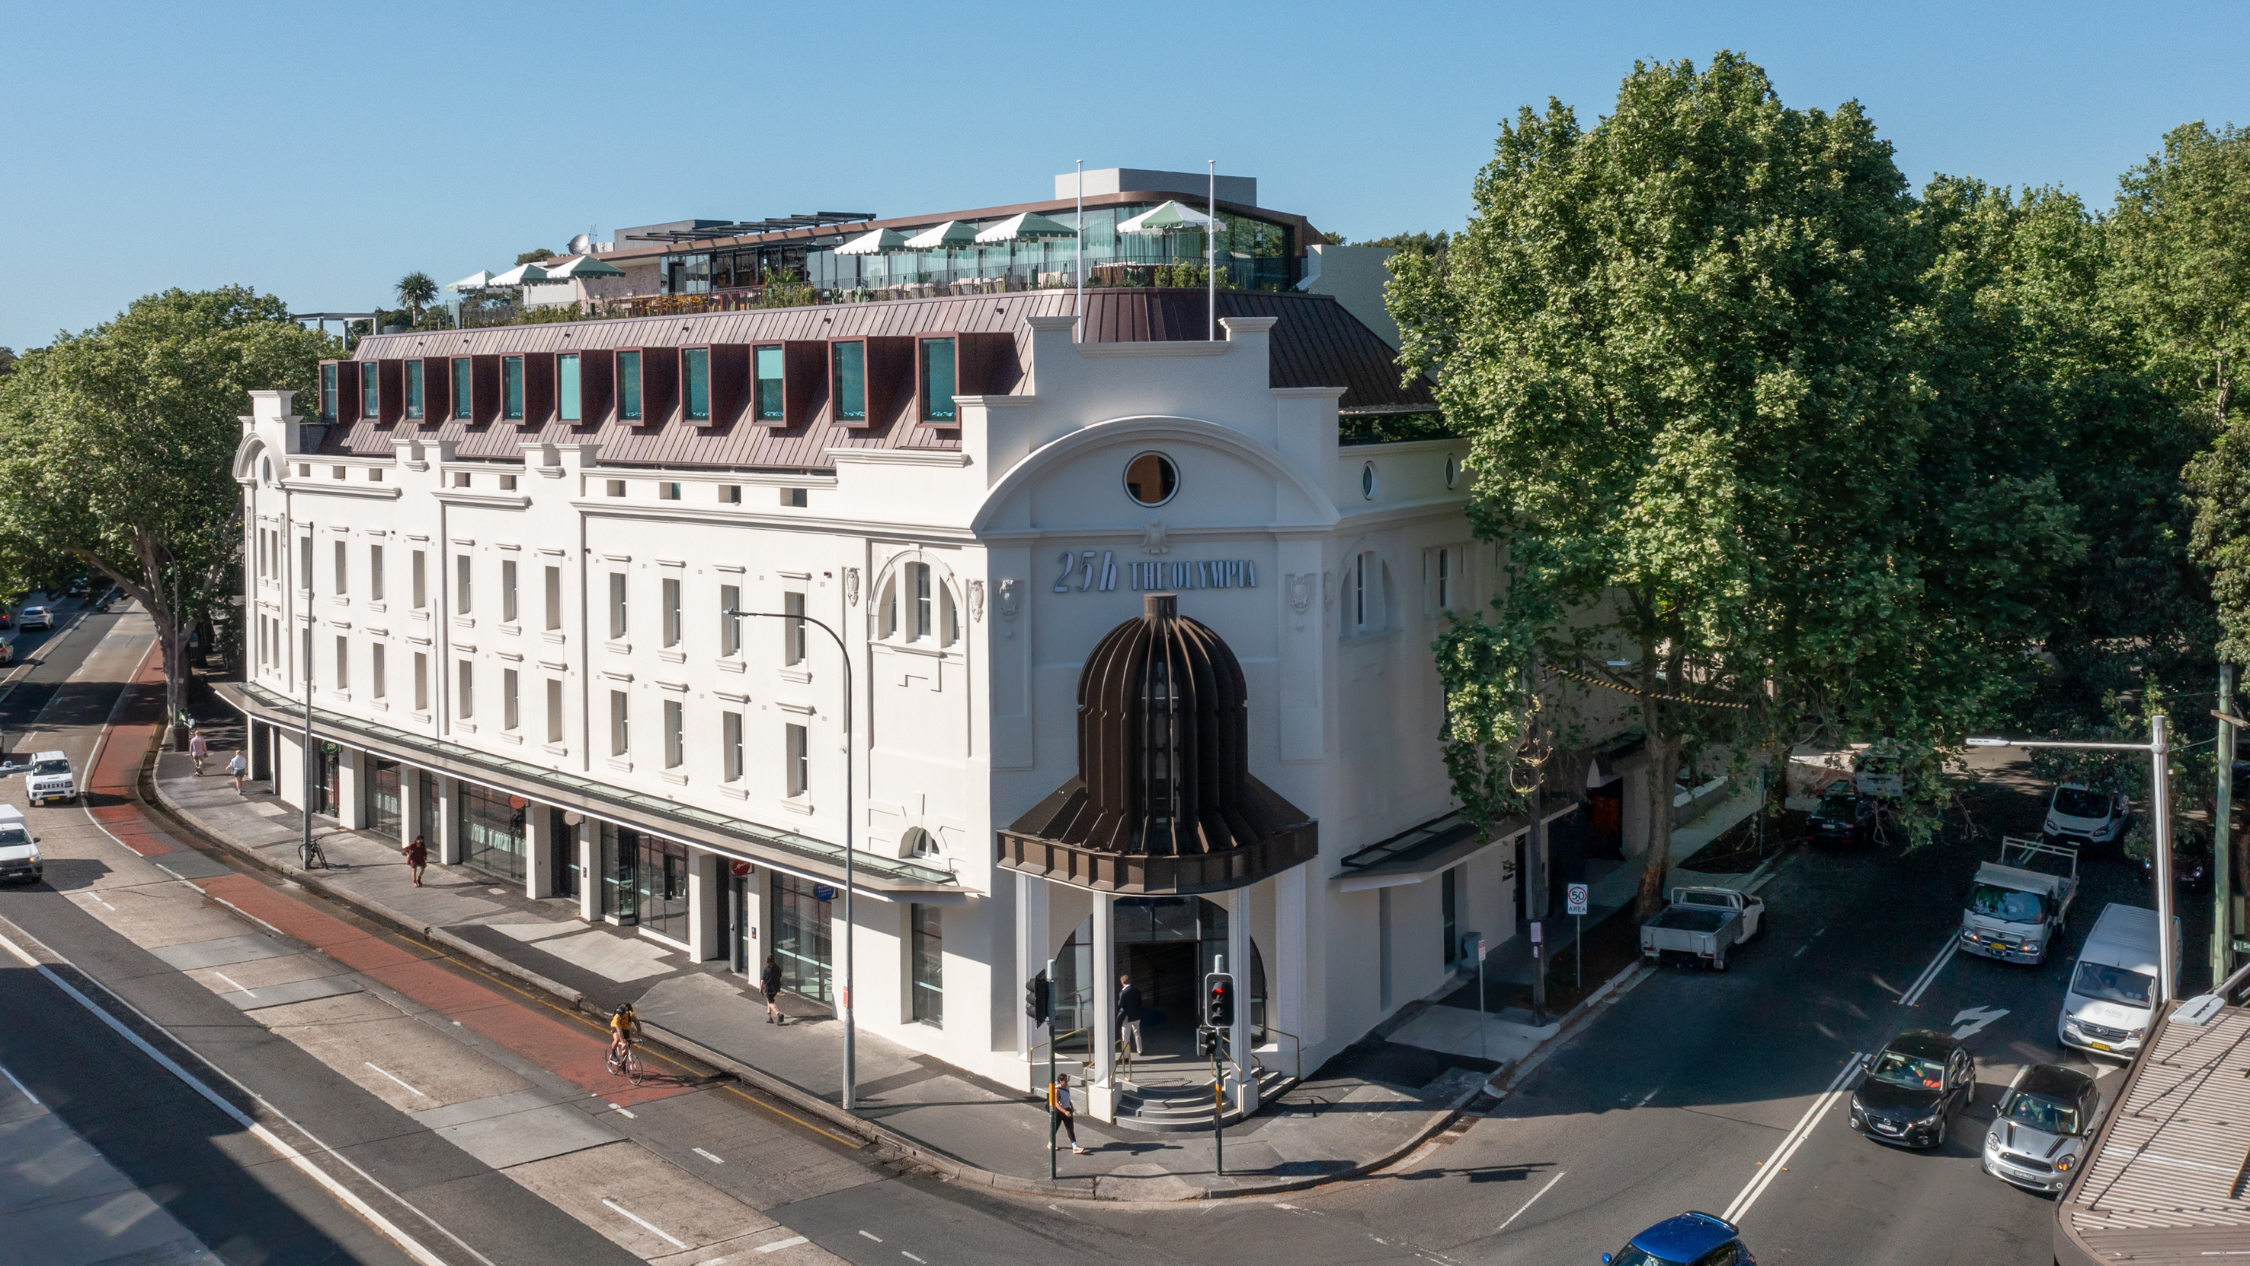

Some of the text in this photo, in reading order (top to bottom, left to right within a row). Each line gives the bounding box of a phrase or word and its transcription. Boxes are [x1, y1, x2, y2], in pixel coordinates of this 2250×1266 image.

[1053, 551, 1257, 593] 25h THE OLYMPIA
[1571, 891, 1585, 900] 50
